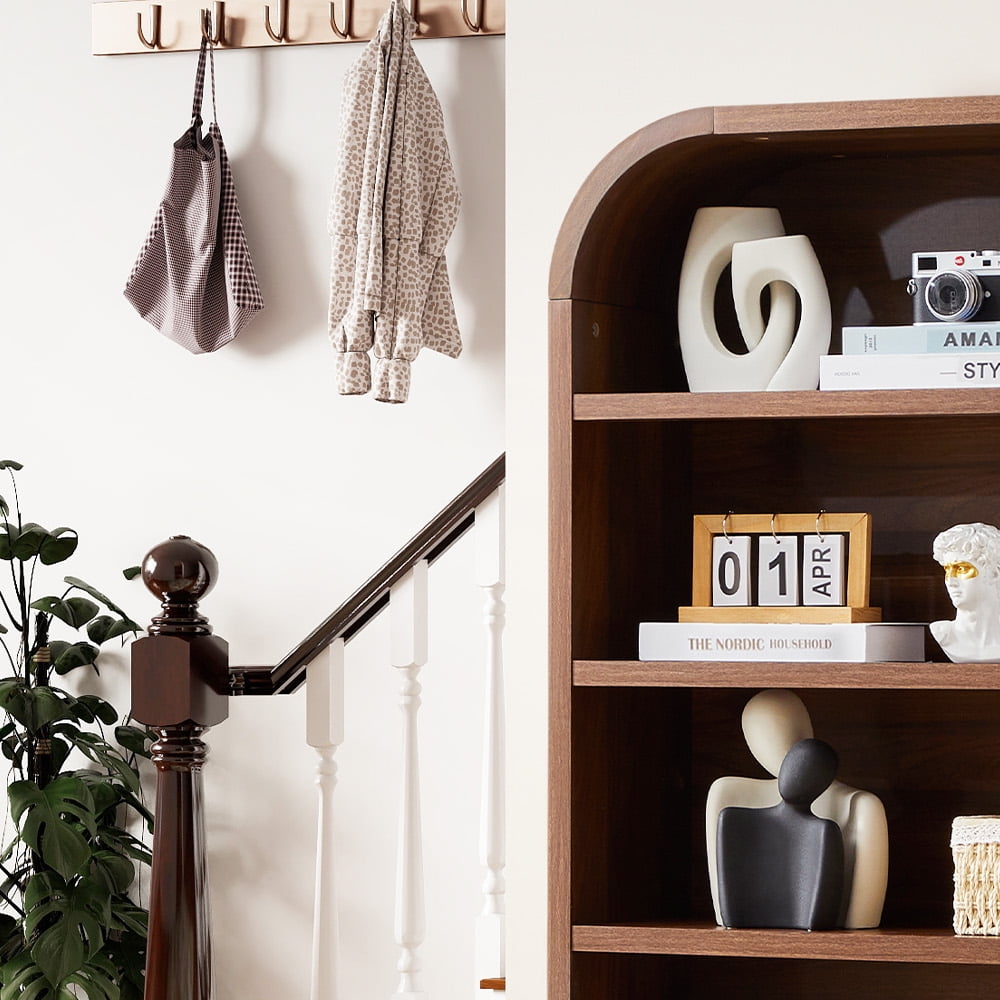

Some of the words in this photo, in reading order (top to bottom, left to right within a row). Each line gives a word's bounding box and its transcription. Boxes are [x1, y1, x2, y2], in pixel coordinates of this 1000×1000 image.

[718, 551, 741, 596] 0
[768, 551, 787, 596] 1
[812, 547, 832, 597] APR
[688, 637, 713, 651] THE
[716, 637, 765, 651] NORDIC
[769, 638, 833, 650] HOUSEHOLD
